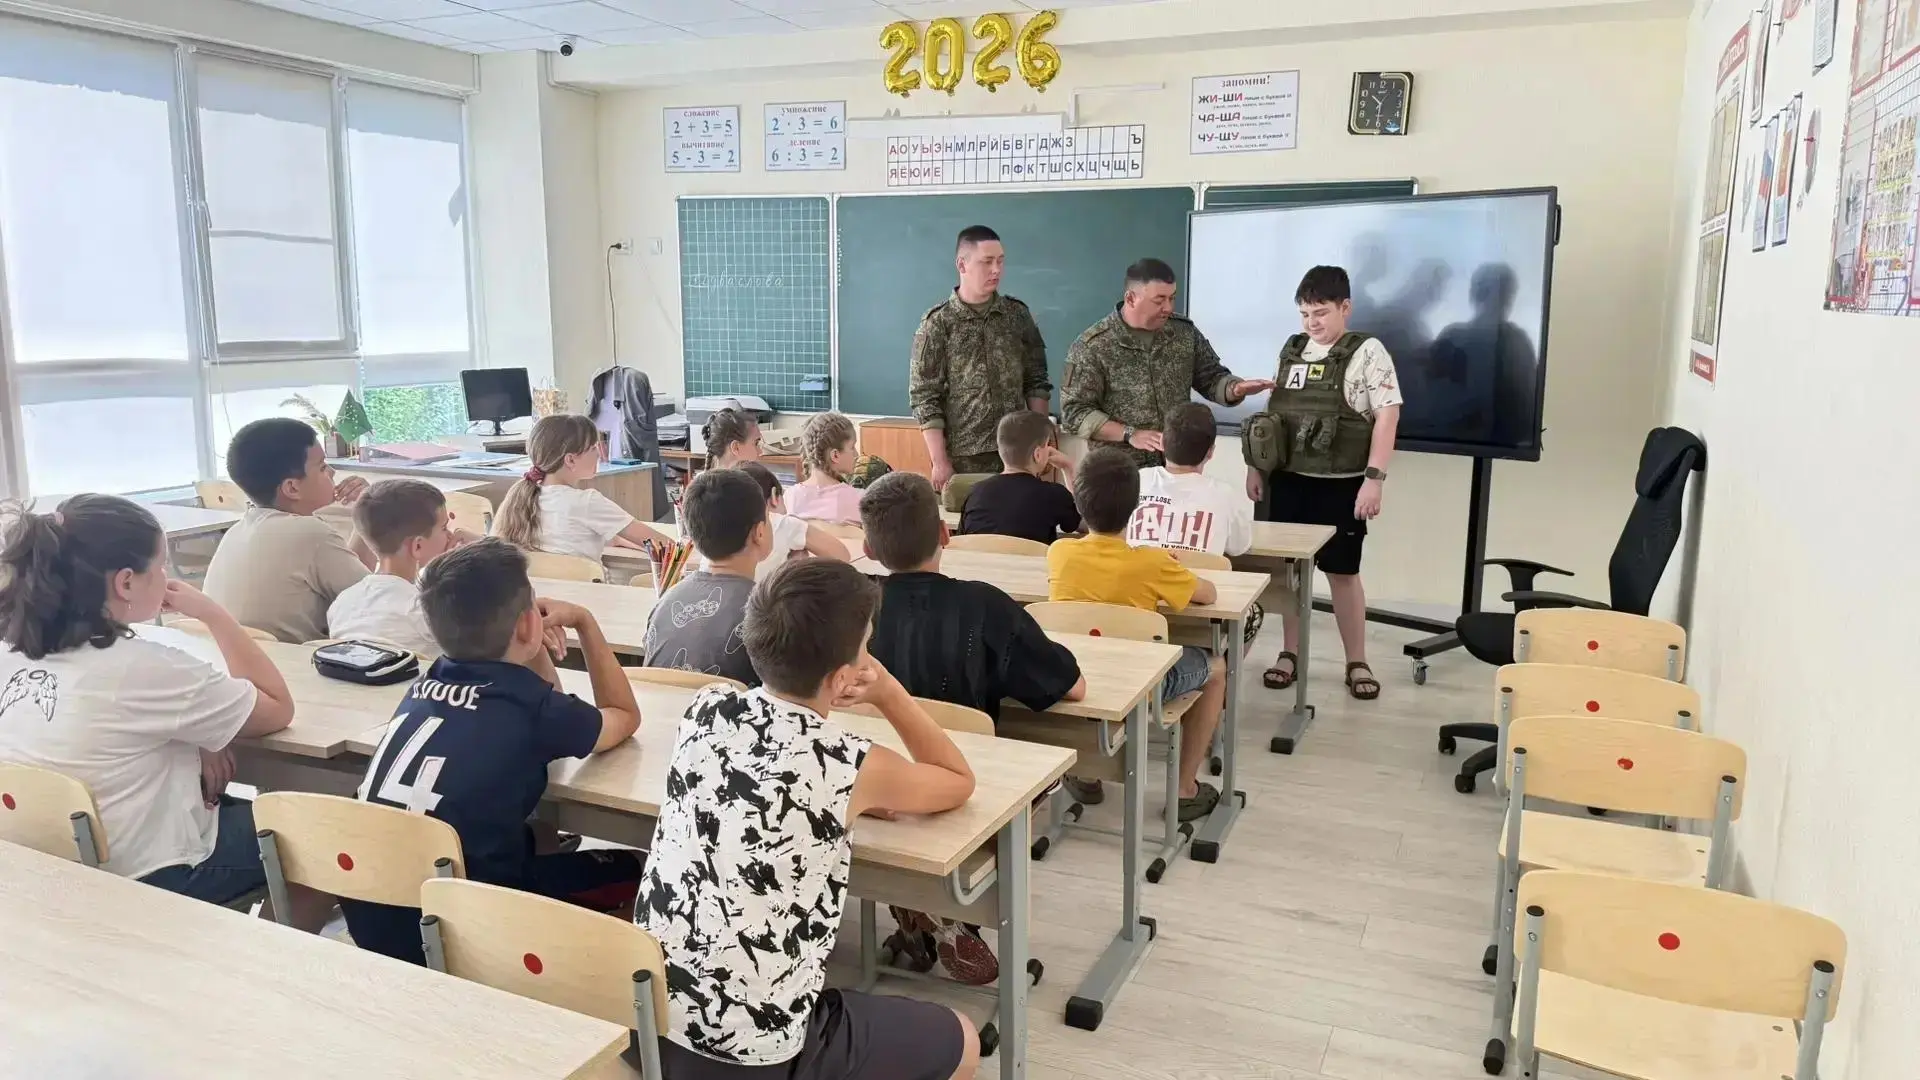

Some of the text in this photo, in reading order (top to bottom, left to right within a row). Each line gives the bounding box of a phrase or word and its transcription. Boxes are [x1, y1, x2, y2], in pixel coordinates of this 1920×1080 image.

[879, 10, 1061, 95] 2026
[1198, 93, 1242, 104] ЖИ-ШИ
[673, 121, 680, 134] 2
[702, 120, 709, 133] 3
[725, 120, 732, 132] 5
[772, 118, 780, 131] 2
[798, 117, 805, 130] 3
[830, 116, 837, 129] 6
[672, 151, 679, 164] 5
[698, 151, 705, 164] 3
[728, 150, 734, 163] 2
[772, 149, 779, 162] 6
[800, 148, 806, 161] 3
[831, 147, 838, 160] 2
[1156, 496, 1172, 504] LOSE
[357, 712, 447, 816] 14
